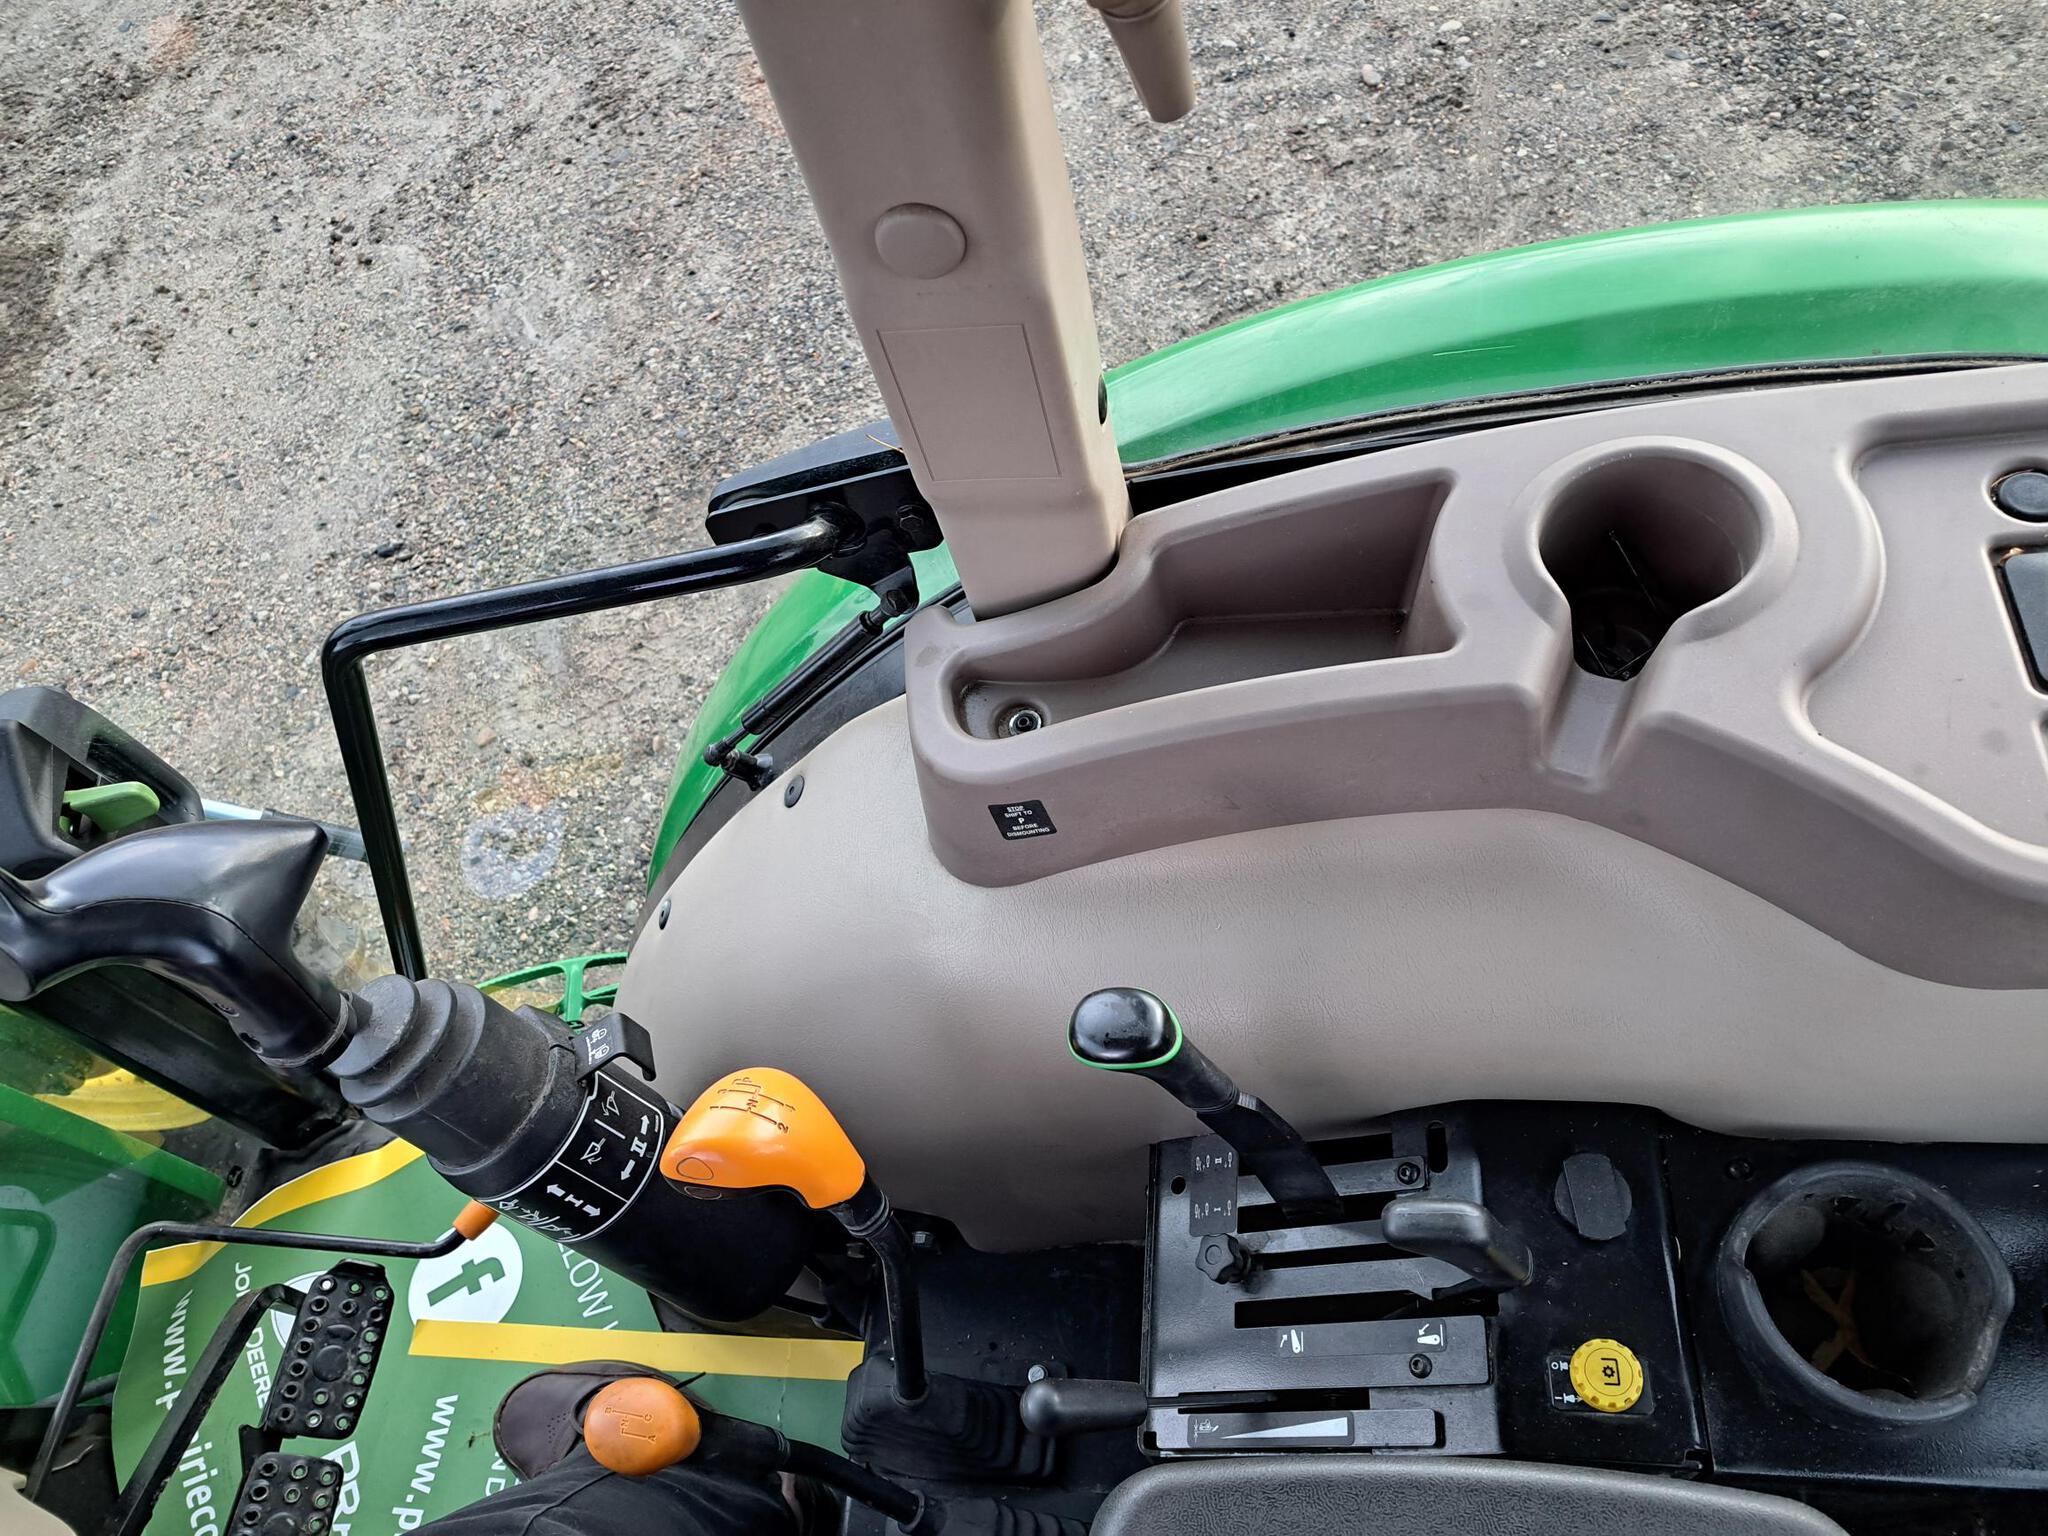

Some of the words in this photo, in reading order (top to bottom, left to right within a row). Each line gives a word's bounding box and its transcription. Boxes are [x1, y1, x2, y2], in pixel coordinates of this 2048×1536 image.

[1007, 827, 1050, 837] DISMOUNTING
[1012, 823, 1038, 831] BEFORE
[777, 1122, 789, 1134] 2
[392, 1394, 459, 1536] www.p
